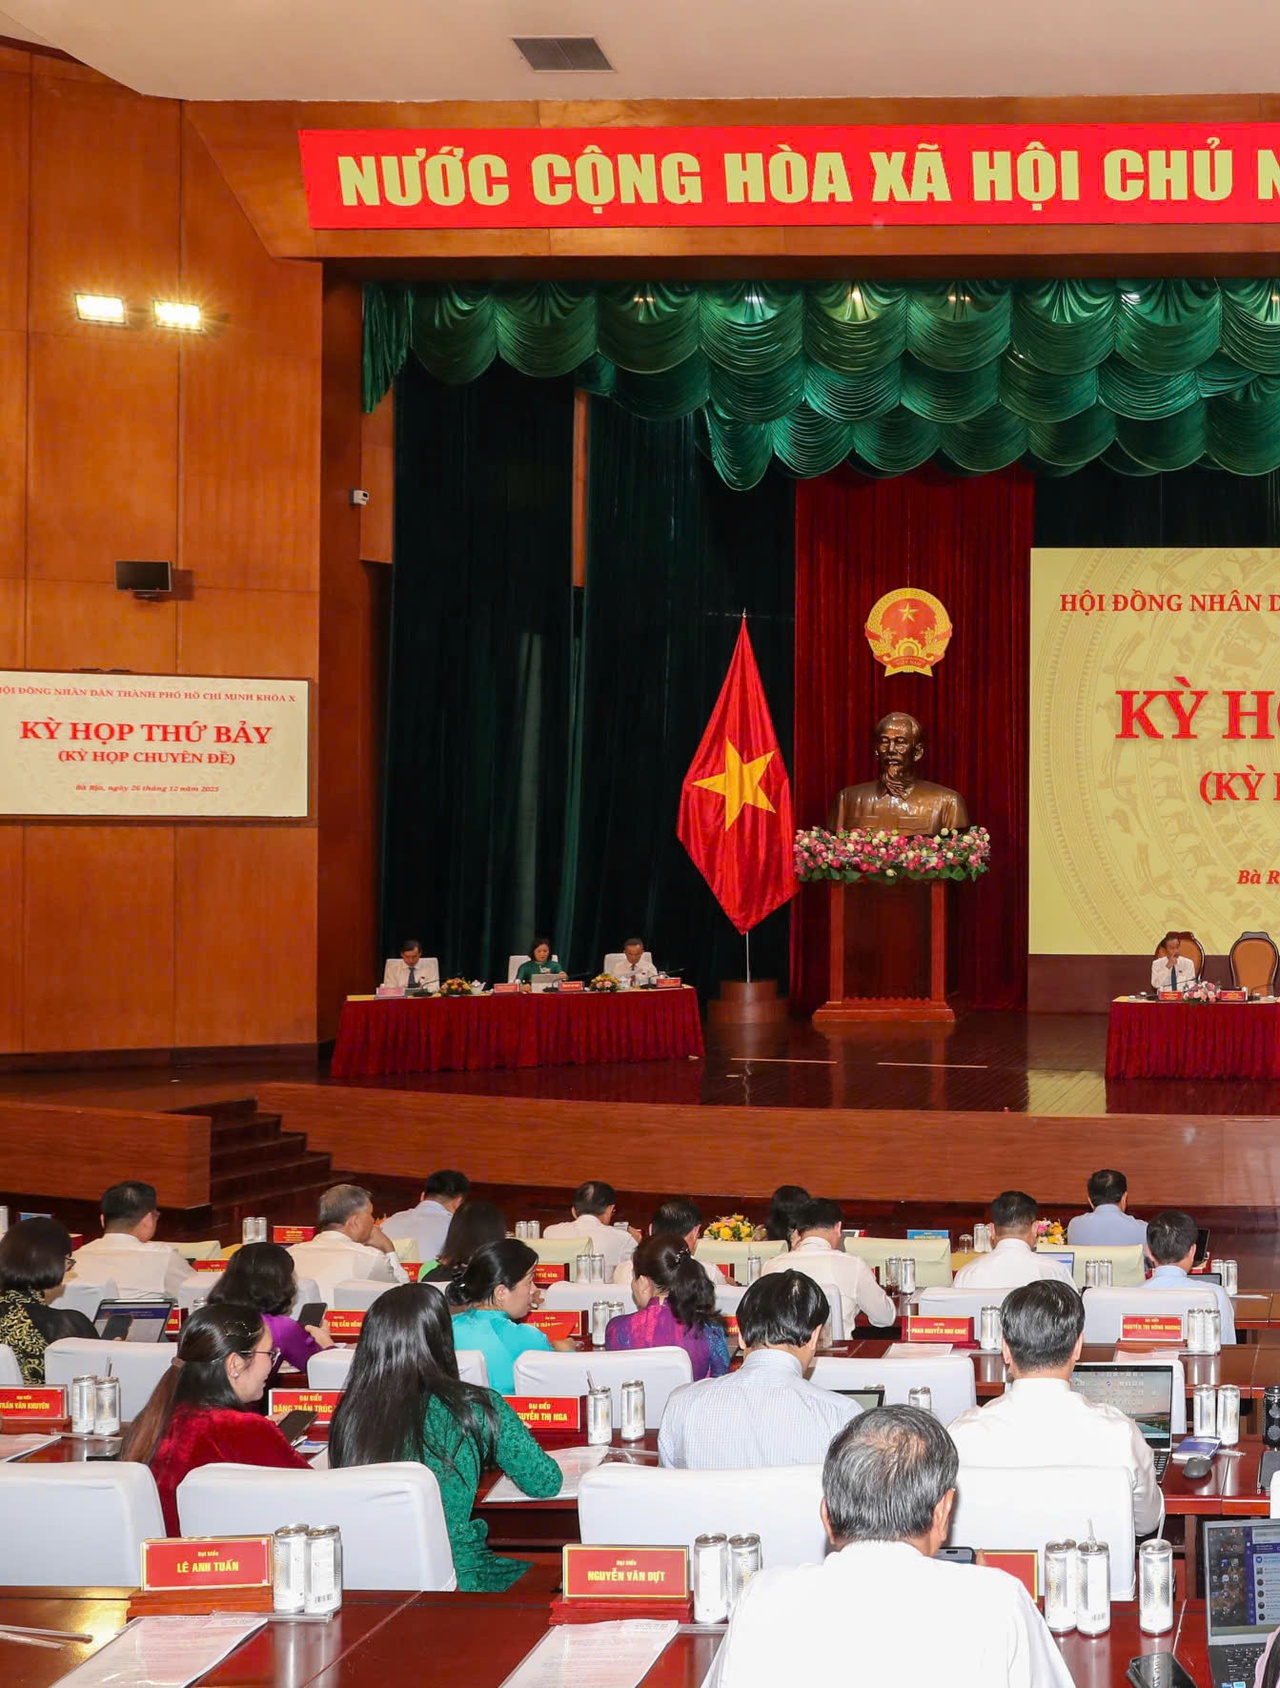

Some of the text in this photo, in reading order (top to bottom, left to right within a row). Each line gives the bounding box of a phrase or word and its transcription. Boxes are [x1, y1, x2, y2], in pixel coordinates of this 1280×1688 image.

[338, 146, 509, 206] NƯỚC
[531, 145, 702, 213] CỘNG
[724, 145, 853, 203] HÒA
[870, 143, 951, 201] XÃ
[973, 142, 1079, 210] HỘI
[1104, 137, 1232, 201] CHỦ
[1060, 590, 1105, 616] HỘI
[1112, 588, 1182, 612] ĐỒNG
[1190, 590, 1262, 612] NHÂN
[18, 686, 51, 696] ĐỒNG
[54, 688, 88, 697] NHÂN
[90, 688, 114, 698] DÂN
[117, 690, 156, 699] THÀNH
[159, 690, 182, 699] PHỐ
[184, 691, 200, 700] HỒ
[203, 692, 222, 700] CHÍ
[225, 693, 253, 701] MINH
[256, 693, 286, 702] KHÓA
[1115, 676, 1209, 740] KỲ
[20, 716, 273, 745] KỲ HỌP THỨ BẢY
[58, 749, 236, 765] (KỲ HỌP CHUYÊN ĐỀ)
[1199, 764, 1266, 805] (KỲ
[1238, 869, 1262, 885] Bà
[517, 1410, 539, 1421] GUYỄN
[177, 1558, 239, 1573] LÊ ANH TUẤN
[587, 1567, 624, 1581] NGUYỄN
[627, 1570, 645, 1581] VĂN
